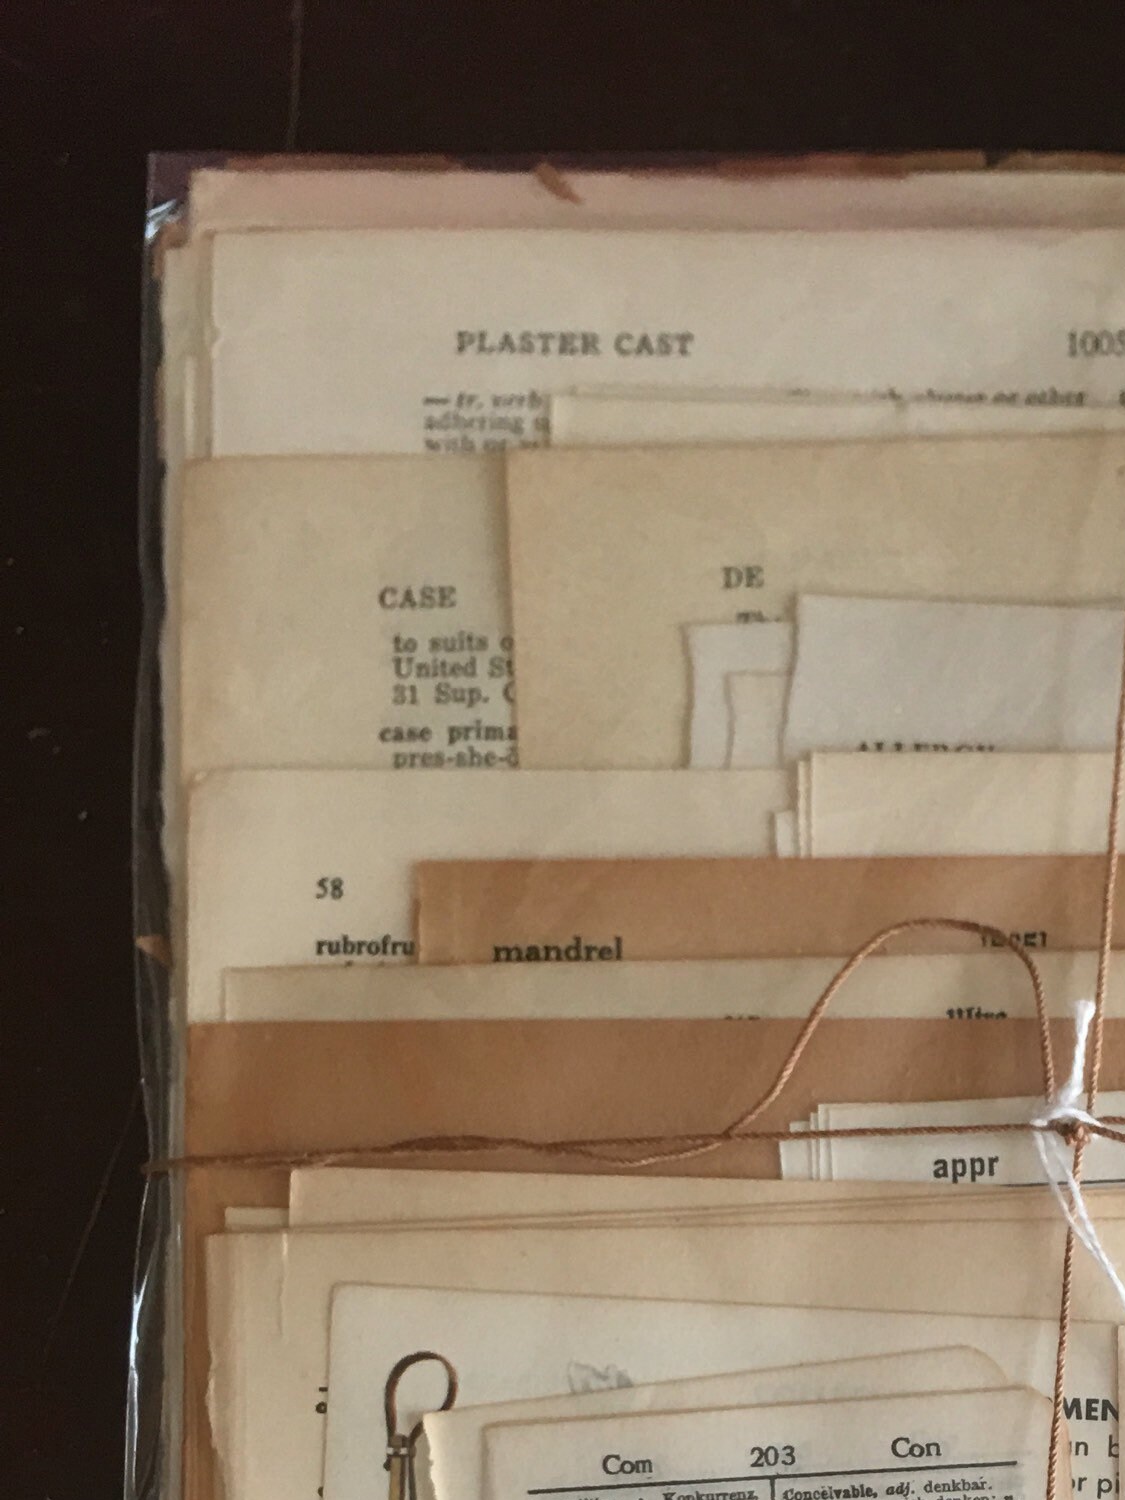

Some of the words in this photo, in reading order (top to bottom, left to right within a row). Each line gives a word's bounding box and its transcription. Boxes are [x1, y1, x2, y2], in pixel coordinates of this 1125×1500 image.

[456, 330, 602, 356] PLASTER
[613, 331, 695, 357] CAST
[720, 565, 765, 590] DE
[377, 585, 457, 610] CASE
[391, 631, 419, 654] to
[428, 631, 489, 654] suits
[391, 656, 478, 680] United
[391, 683, 420, 706] 31
[433, 682, 491, 709] Sup.
[315, 876, 344, 900] 58
[491, 936, 624, 963] mandrel
[932, 1156, 1000, 1184] appr
[749, 1444, 796, 1468] 203
[890, 1436, 943, 1459] Con
[601, 1454, 654, 1476] Com
[885, 1481, 916, 1500] adj.
[922, 1476, 994, 1495] denkbar.
